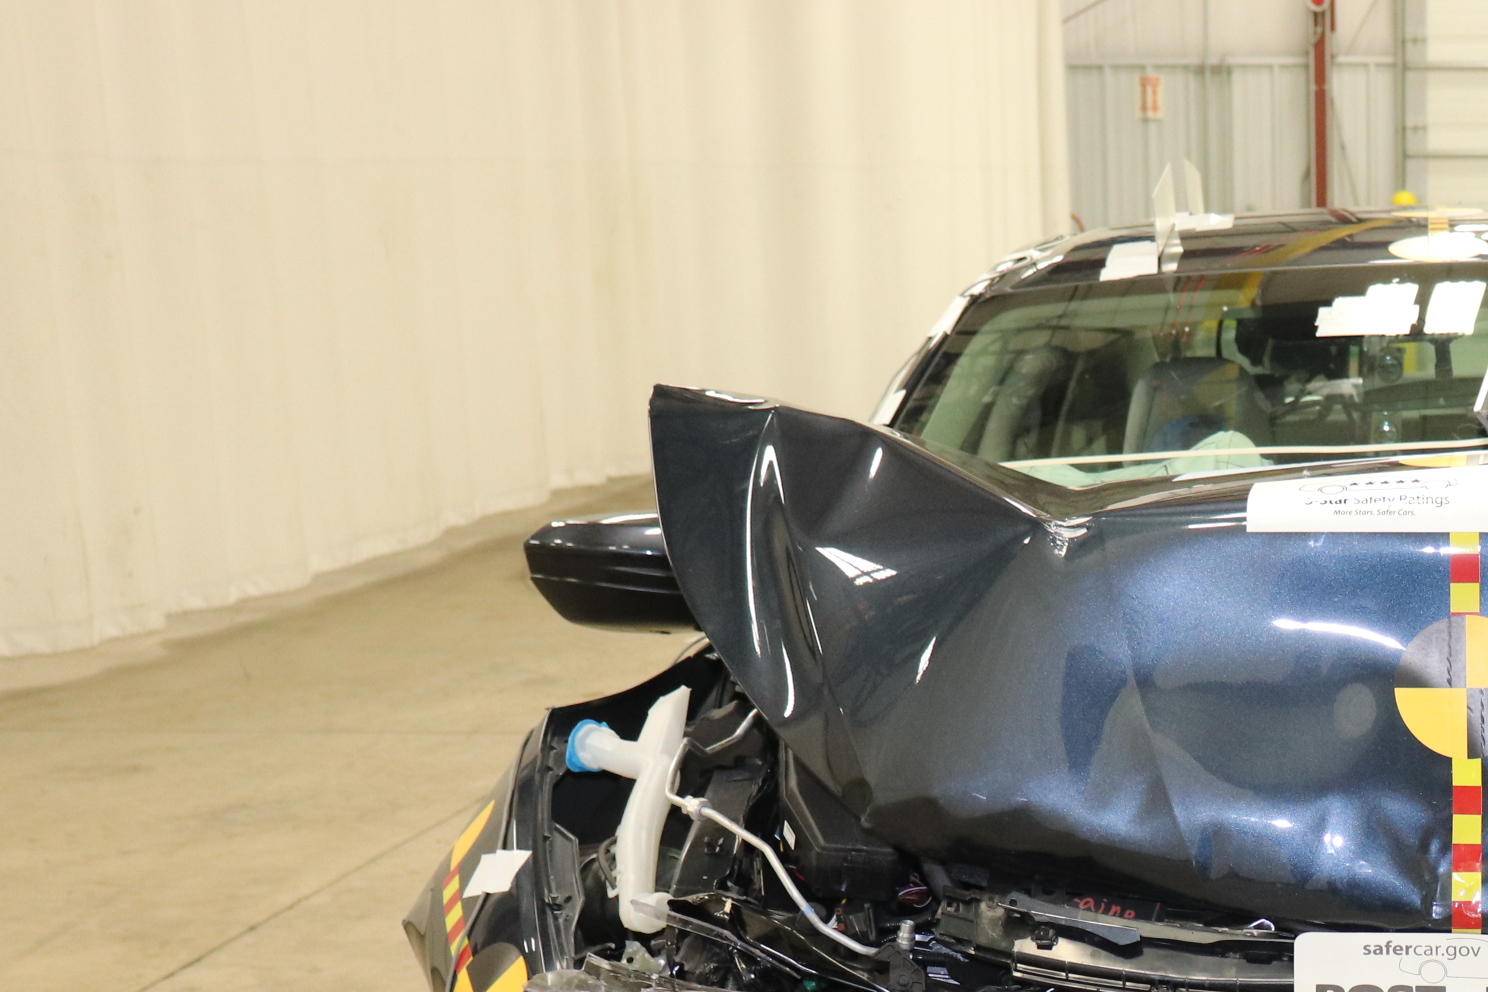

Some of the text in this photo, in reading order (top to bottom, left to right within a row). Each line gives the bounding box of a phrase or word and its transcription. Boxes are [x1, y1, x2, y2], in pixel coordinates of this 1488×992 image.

[1399, 494, 1450, 508] Ratings
[1354, 508, 1375, 516] Stars.
[1376, 508, 1397, 516] Safer
[1397, 508, 1416, 517] Cars.
[1362, 940, 1482, 960] safercar.gov
